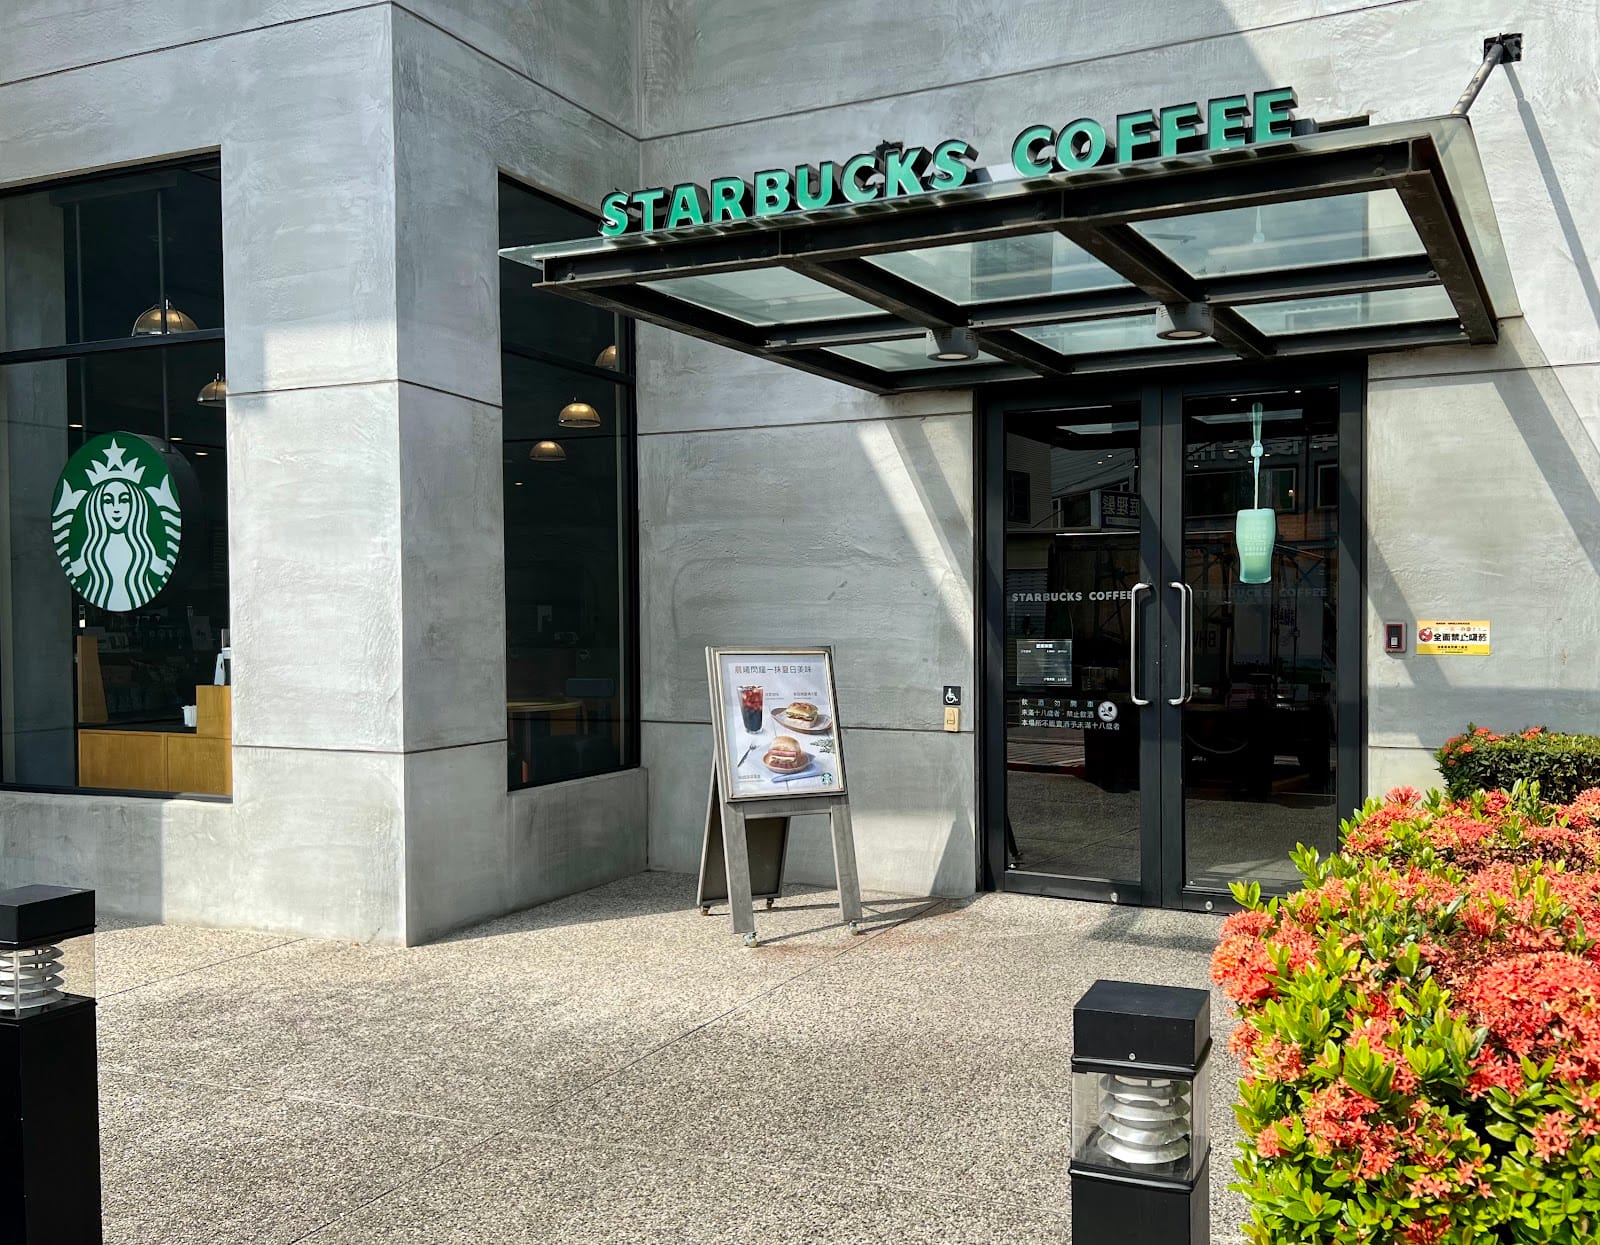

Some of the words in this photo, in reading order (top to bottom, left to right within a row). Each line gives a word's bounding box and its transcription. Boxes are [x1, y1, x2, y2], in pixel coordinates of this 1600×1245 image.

[600, 140, 974, 237] STARBUCKS
[1011, 88, 1297, 178] COFFEE
[1012, 591, 1083, 602] STARBUCKS
[1089, 590, 1132, 601] COFFEE
